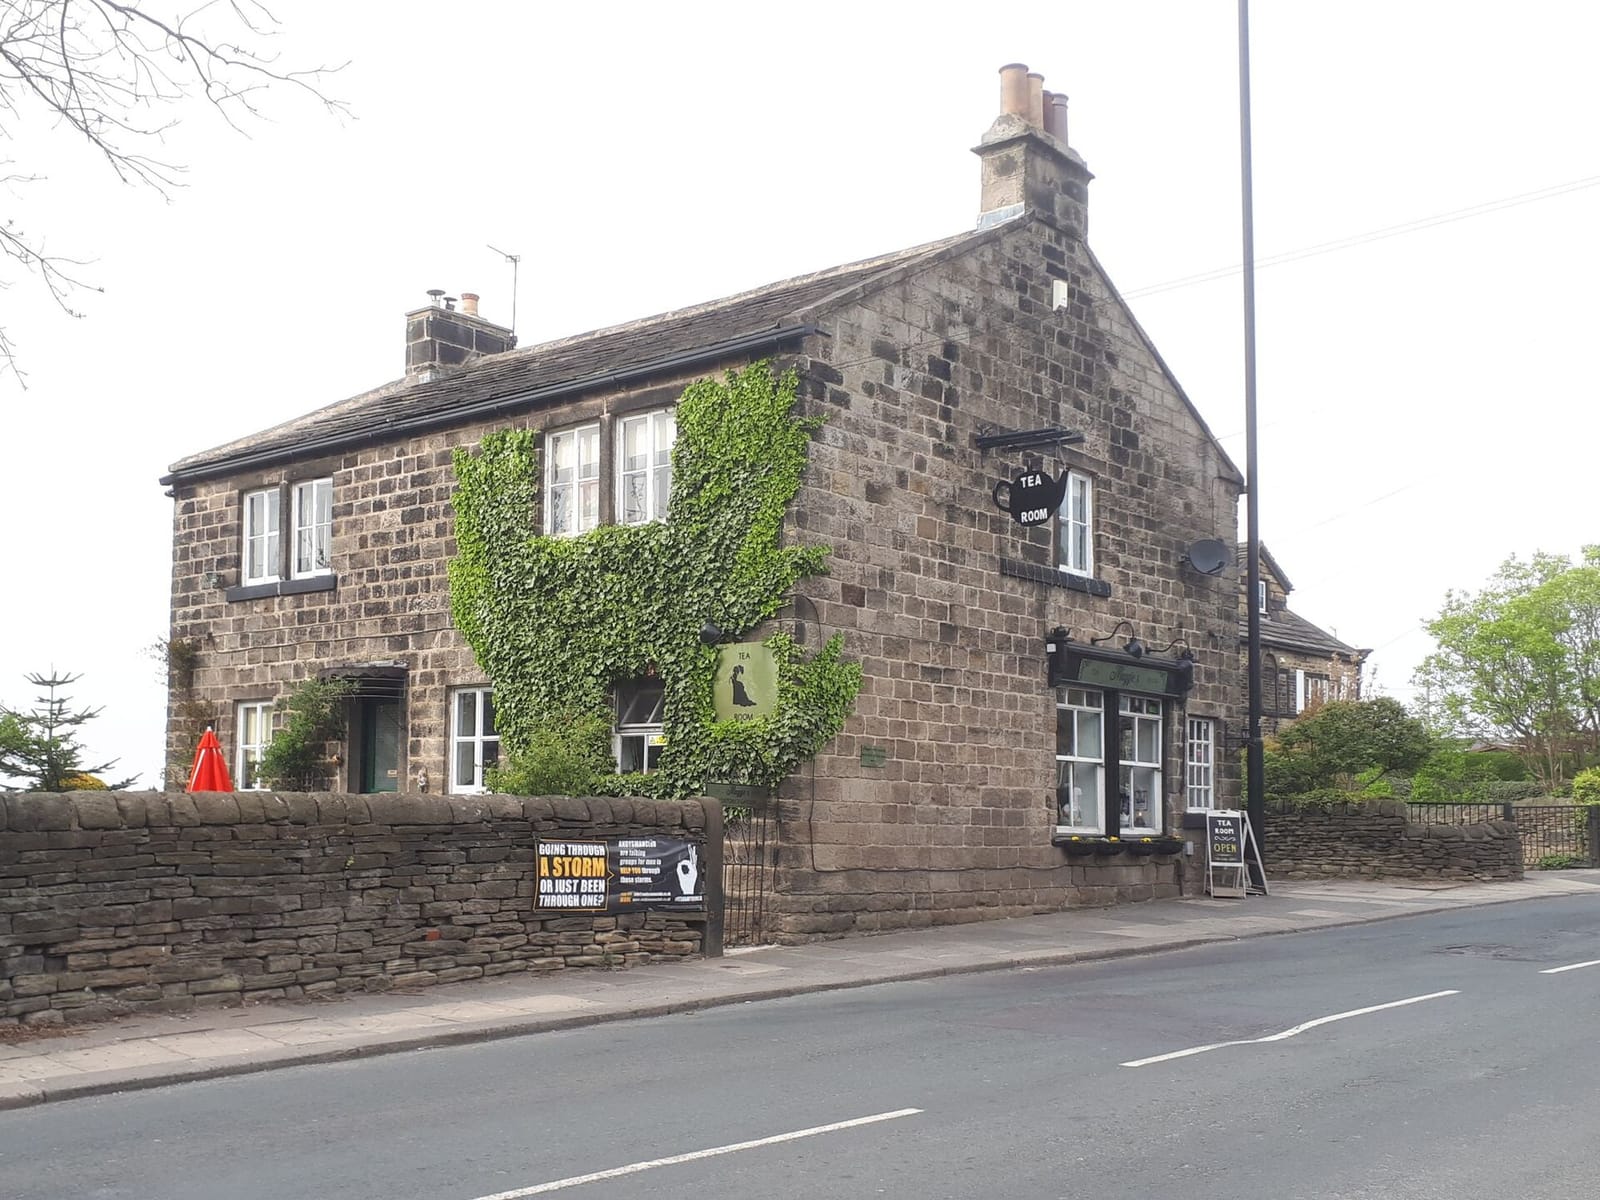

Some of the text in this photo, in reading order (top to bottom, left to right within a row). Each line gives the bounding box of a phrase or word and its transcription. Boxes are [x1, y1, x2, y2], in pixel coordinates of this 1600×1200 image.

[1020, 474, 1042, 488] TEA
[1020, 508, 1048, 523] ROOM
[738, 652, 750, 660] TEA
[734, 713, 753, 721] ROOM
[539, 843, 606, 856] GOING THROUGH
[1213, 843, 1237, 853] OPEN
[540, 857, 605, 877] A STORM
[540, 879, 605, 893] OR JUST BEEN
[539, 894, 580, 907] THROUGH
[581, 894, 605, 906] ONE?
